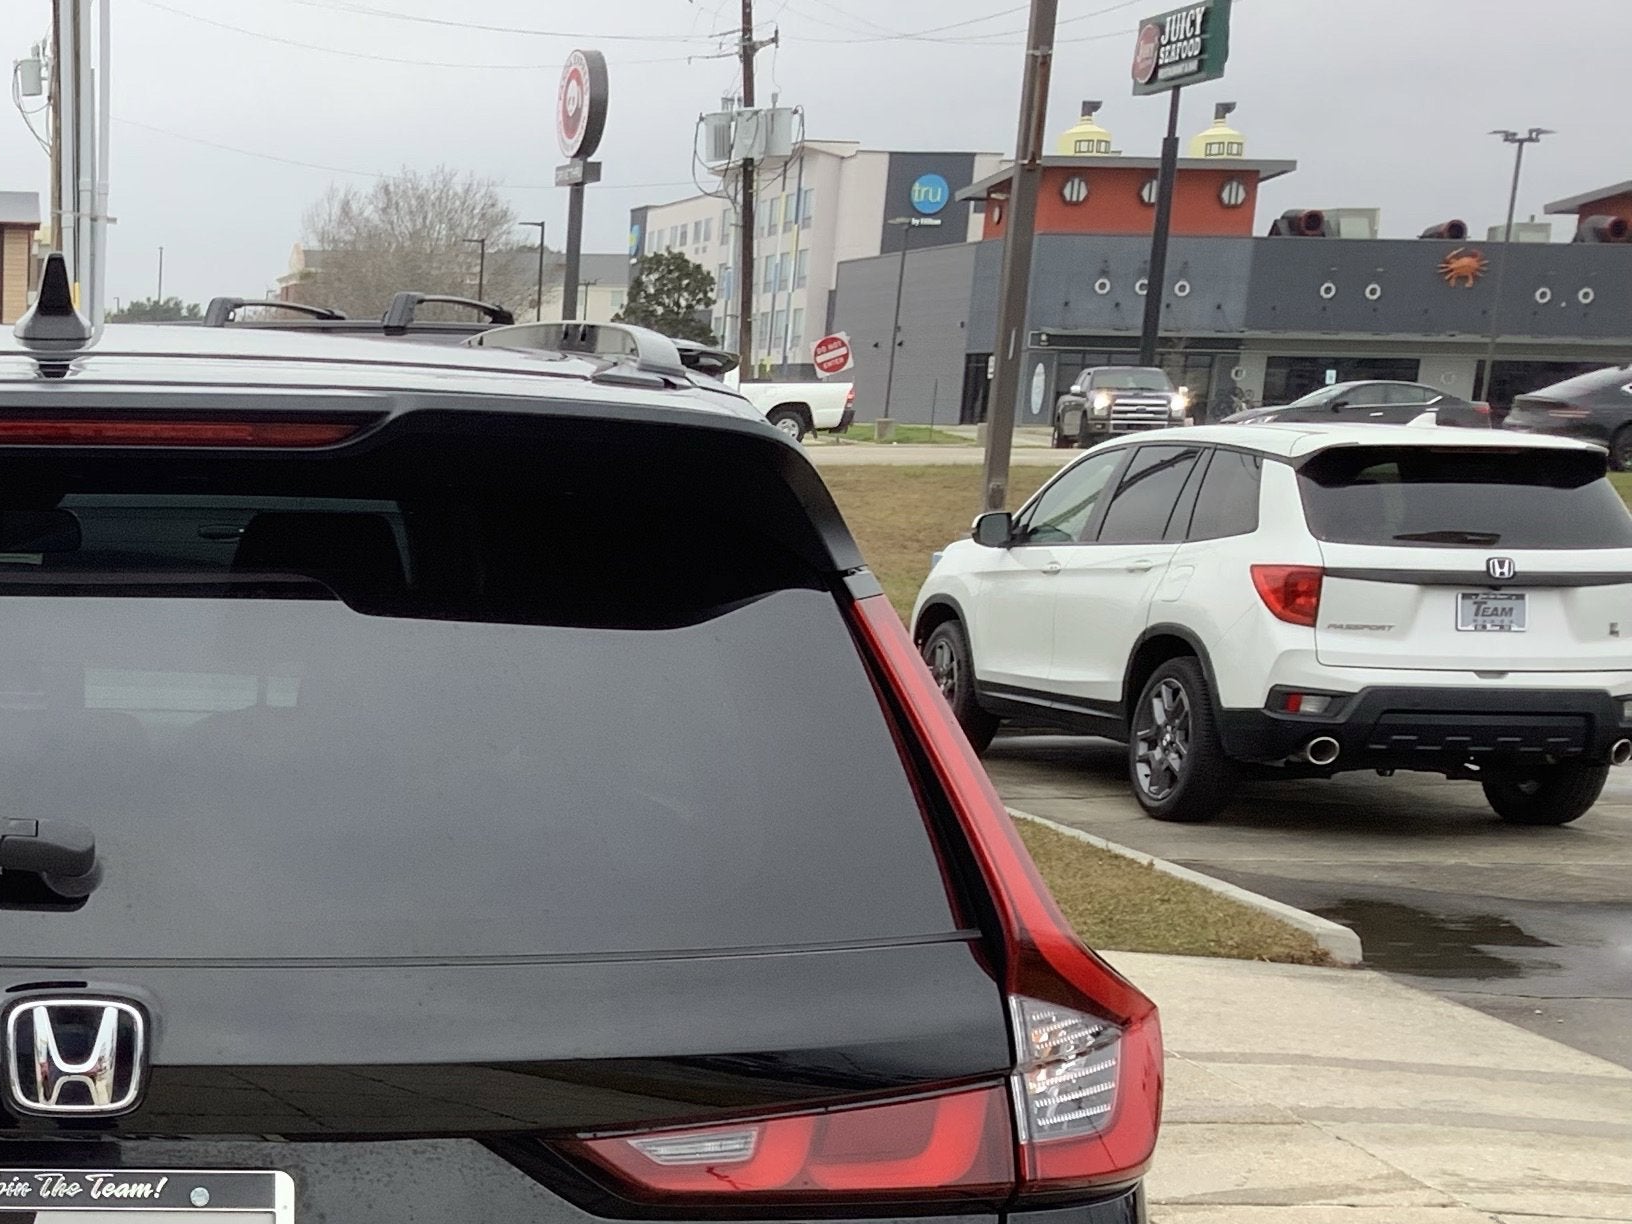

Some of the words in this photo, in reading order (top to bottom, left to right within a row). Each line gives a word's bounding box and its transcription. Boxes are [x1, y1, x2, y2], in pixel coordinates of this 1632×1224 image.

[1160, 6, 1205, 45] JUICY
[1158, 37, 1202, 65] SEAFOOD
[913, 182, 942, 203] tru
[1473, 601, 1514, 617] TEAM
[1327, 623, 1396, 632] PASSPORT
[34, 1173, 83, 1199] The
[85, 1173, 168, 1199] Team!
